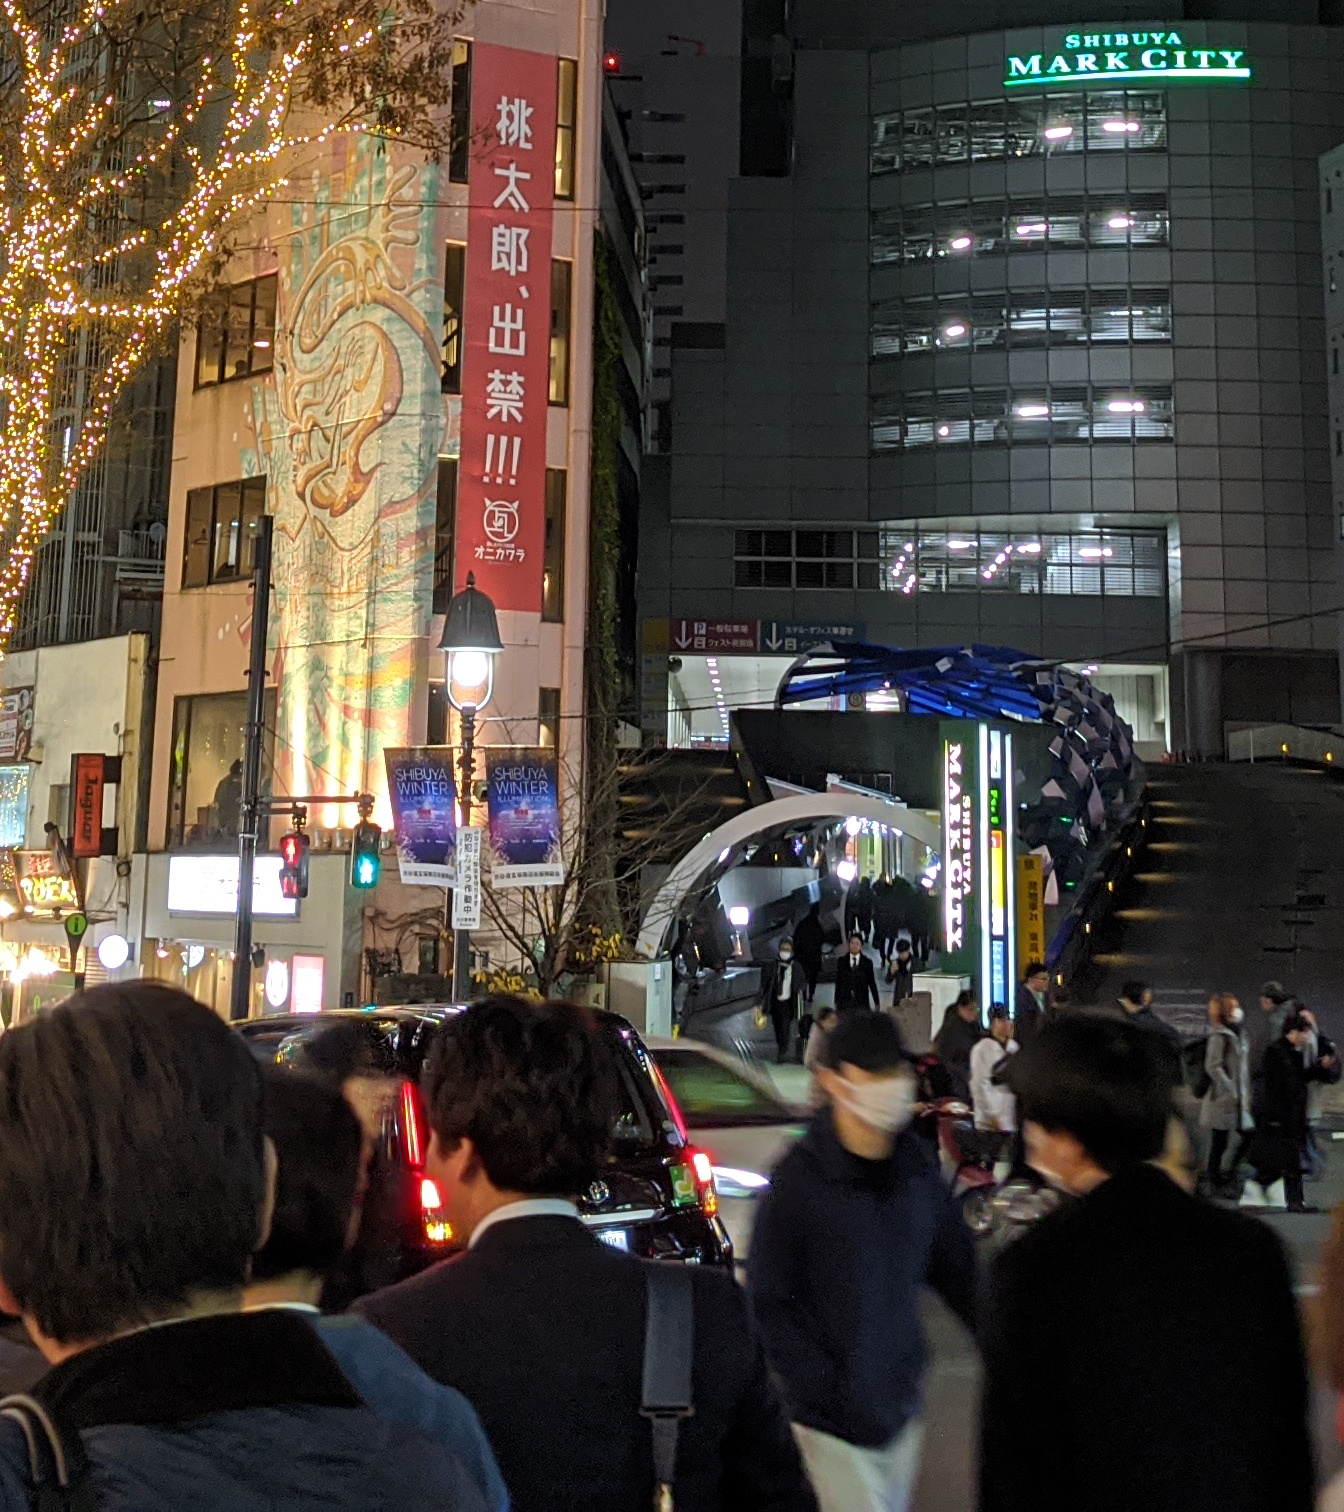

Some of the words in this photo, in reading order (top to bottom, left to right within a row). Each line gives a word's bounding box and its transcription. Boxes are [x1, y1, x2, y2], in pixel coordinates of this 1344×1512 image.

[1065, 32, 1182, 49] SHIBUYA
[1008, 51, 1130, 77] MARK
[1141, 49, 1244, 70] CITY
[474, 544, 526, 563] オニカワラ
[395, 767, 448, 781] SHIBUYA
[494, 766, 548, 781] SHIBUYA
[397, 781, 448, 795] WINTER
[495, 781, 549, 795] WINTER
[948, 743, 962, 851] MARK
[82, 774, 99, 844] Jaguar
[463, 833, 473, 914] 防犯カメラ作動中
